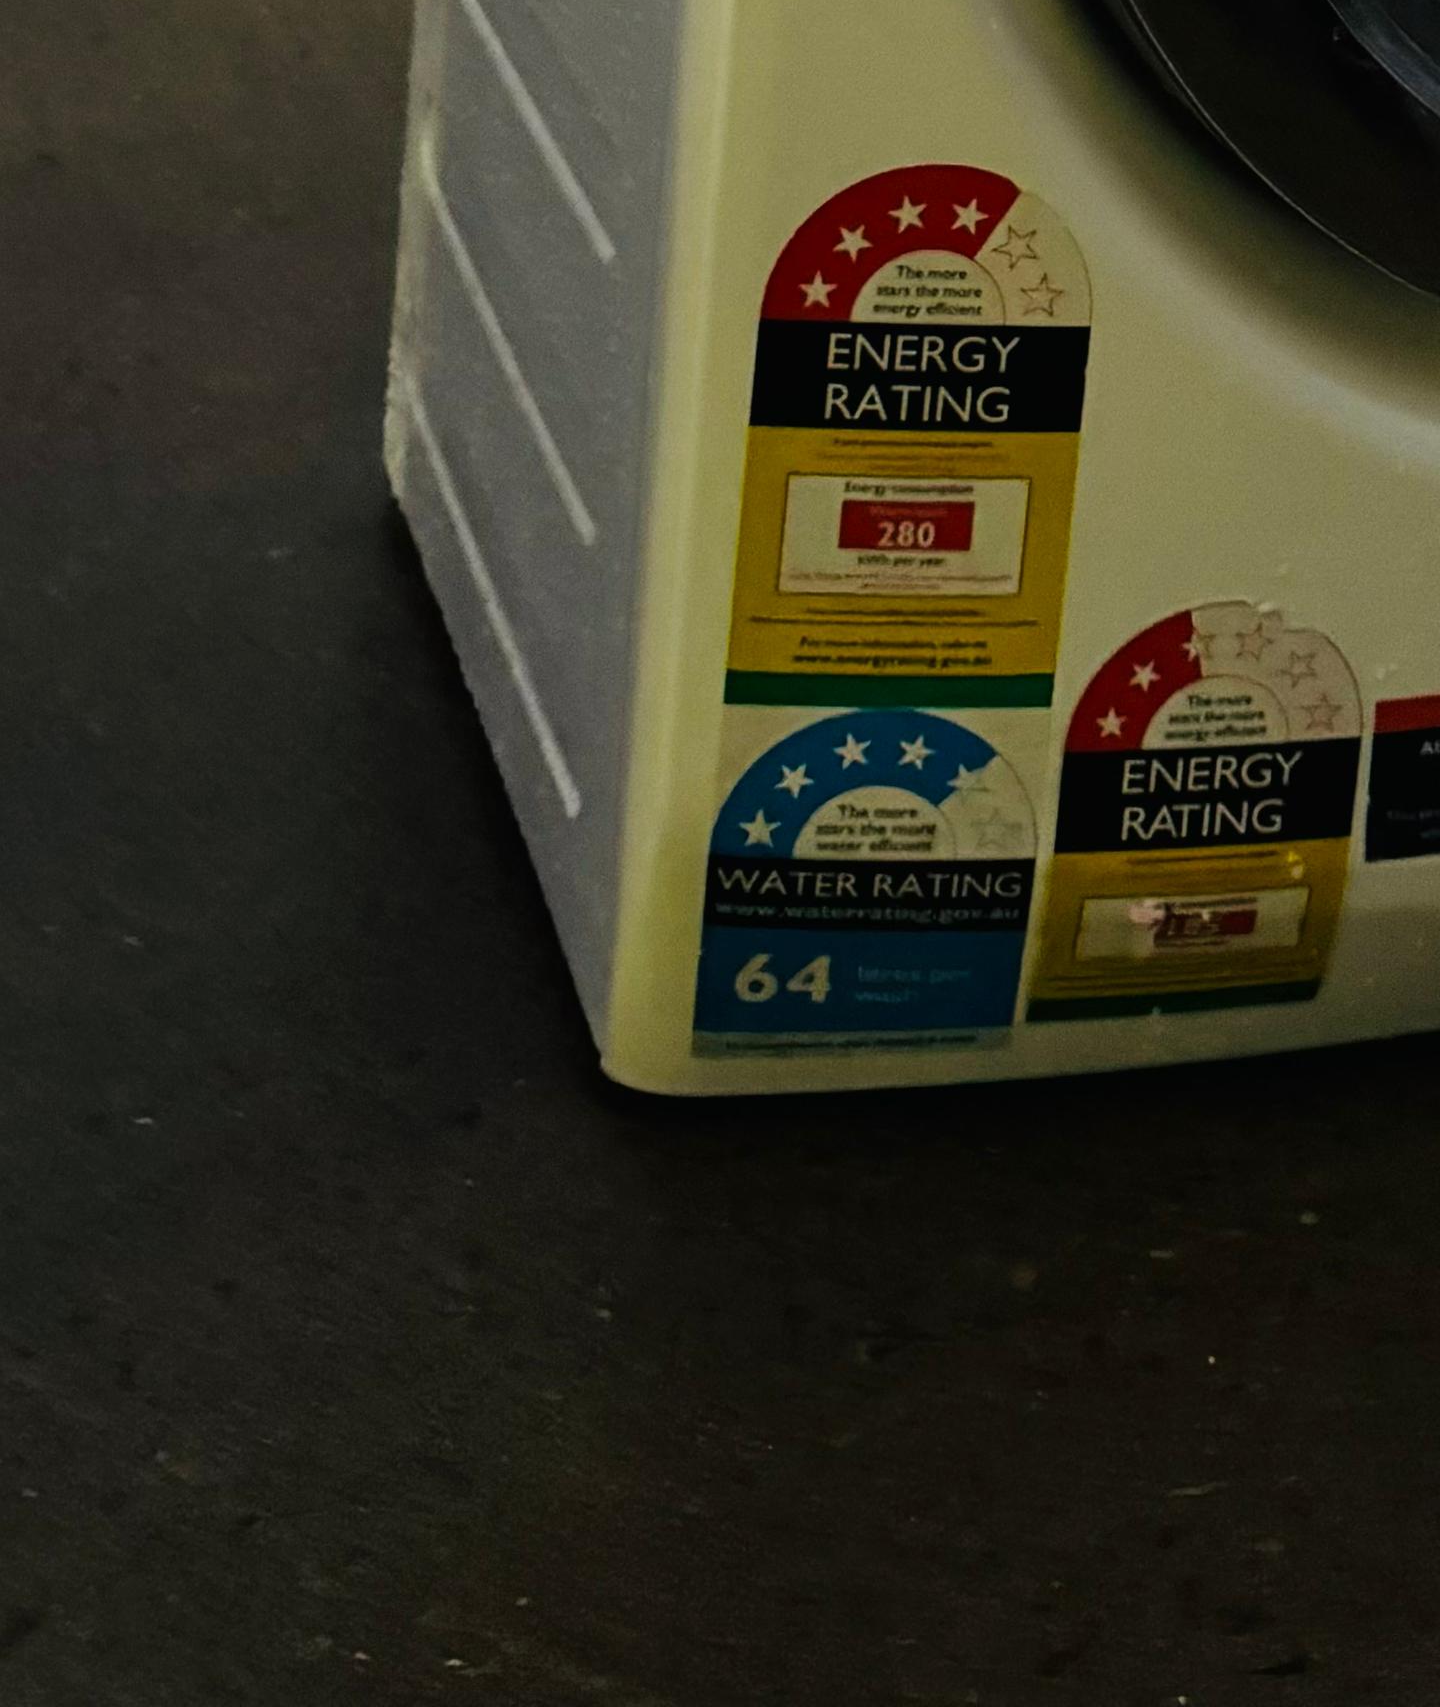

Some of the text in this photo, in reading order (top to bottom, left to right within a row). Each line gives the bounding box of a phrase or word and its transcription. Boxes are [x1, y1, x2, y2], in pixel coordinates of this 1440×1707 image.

[897, 265, 967, 280] The more
[877, 285, 982, 298] stars the more
[873, 302, 982, 318] energy efficient
[826, 332, 1020, 373] ENERGY
[824, 382, 1010, 423] RATING
[877, 521, 936, 548] 280
[1121, 751, 1303, 795] ENERGY
[838, 804, 917, 818] The more
[1121, 799, 1283, 842] RATING
[861, 823, 886, 835] the
[717, 867, 1022, 899] WATER RATING
[734, 953, 832, 1004] 64
